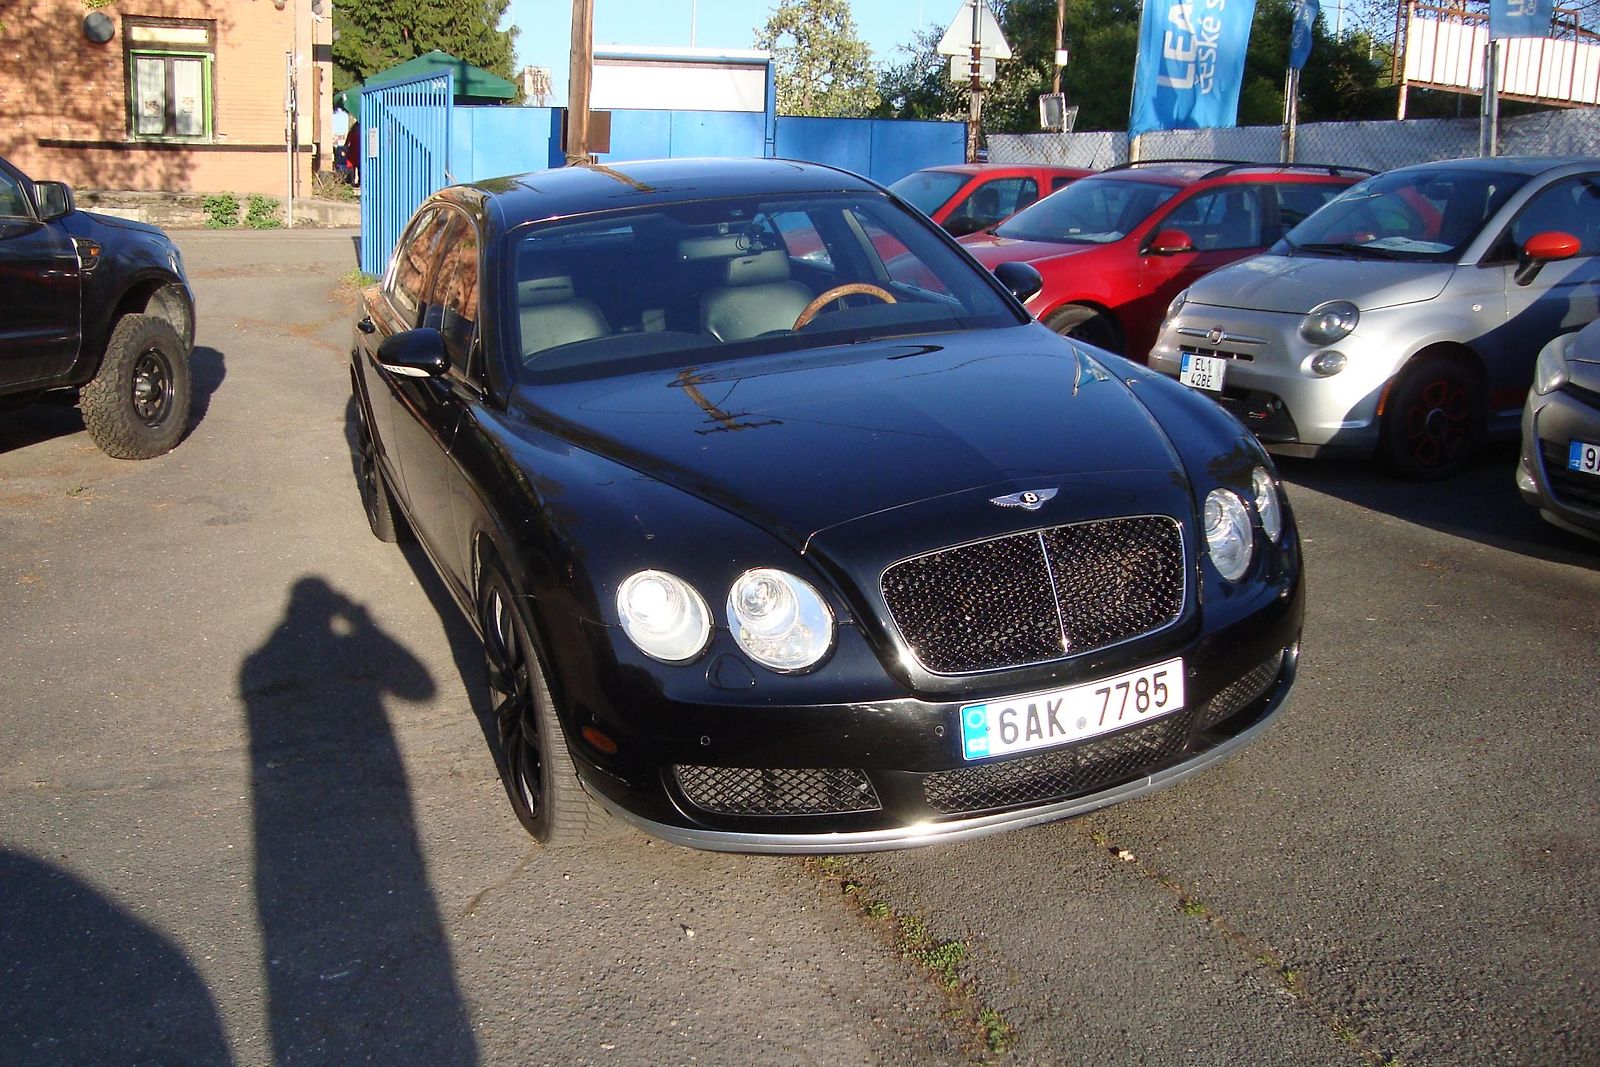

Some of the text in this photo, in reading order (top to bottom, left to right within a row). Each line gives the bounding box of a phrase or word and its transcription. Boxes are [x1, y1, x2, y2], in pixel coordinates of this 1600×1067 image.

[1157, 0, 1197, 89] LEA
[1195, 358, 1212, 373] EL1
[999, 670, 1168, 745] 6AK 7785
